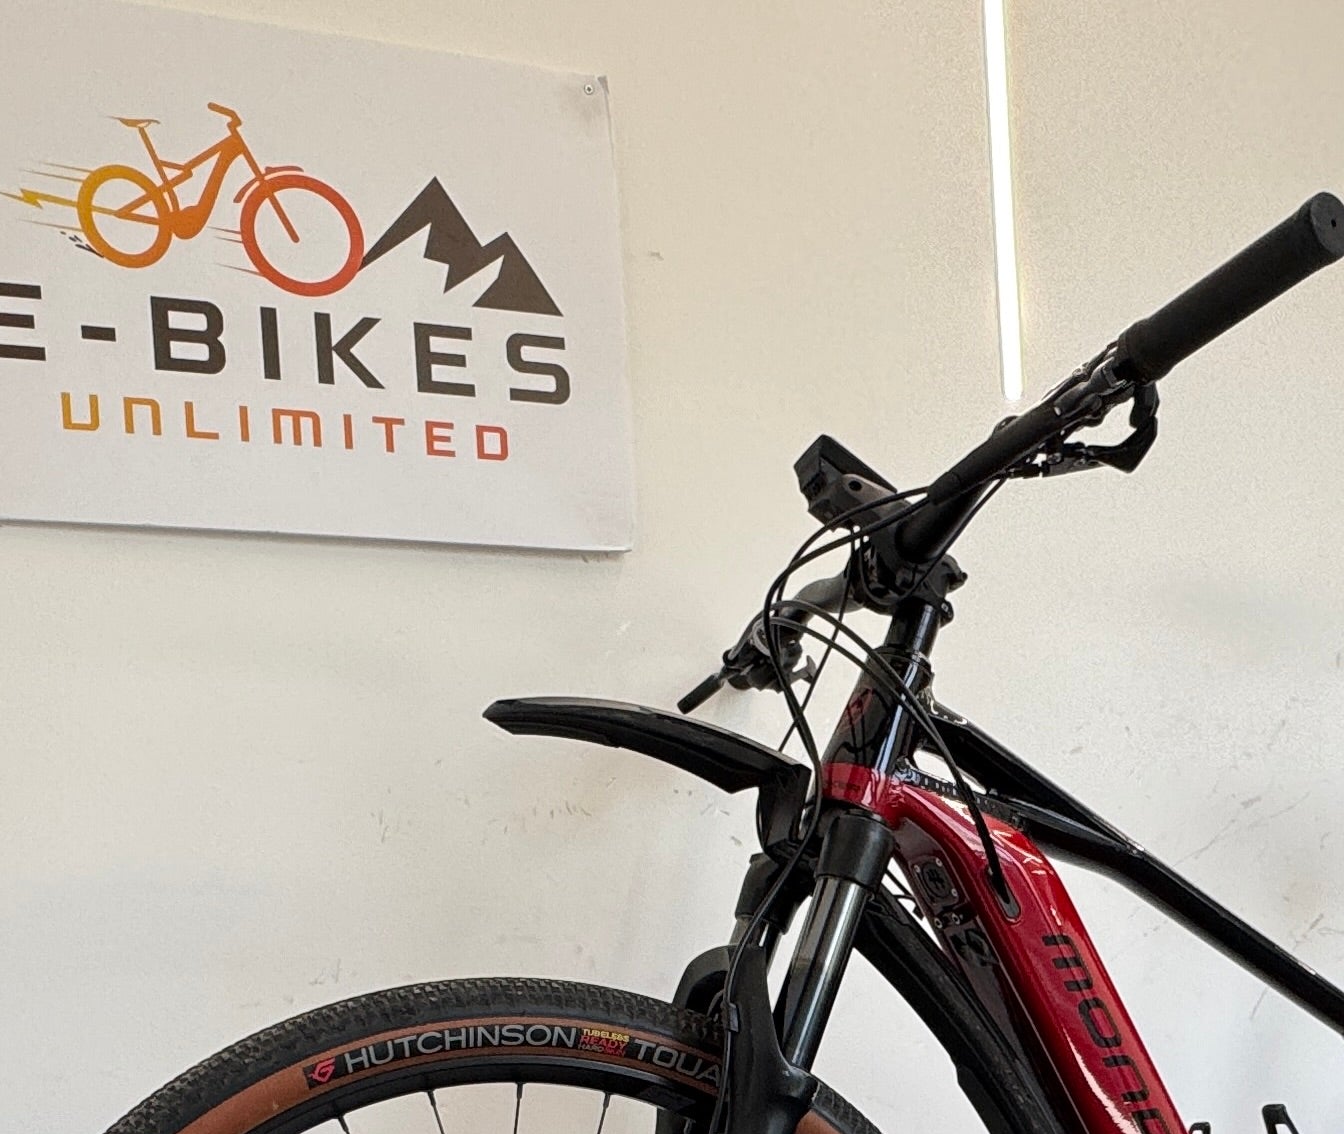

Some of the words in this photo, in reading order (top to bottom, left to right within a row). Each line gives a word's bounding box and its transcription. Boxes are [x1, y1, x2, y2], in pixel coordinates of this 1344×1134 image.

[60, 392, 509, 461] UNLIMITED
[579, 1035, 627, 1050] READY
[582, 1028, 630, 1043] TUBELESS
[343, 1024, 577, 1075] HUTCHINSON
[633, 1038, 724, 1089] TOUA
